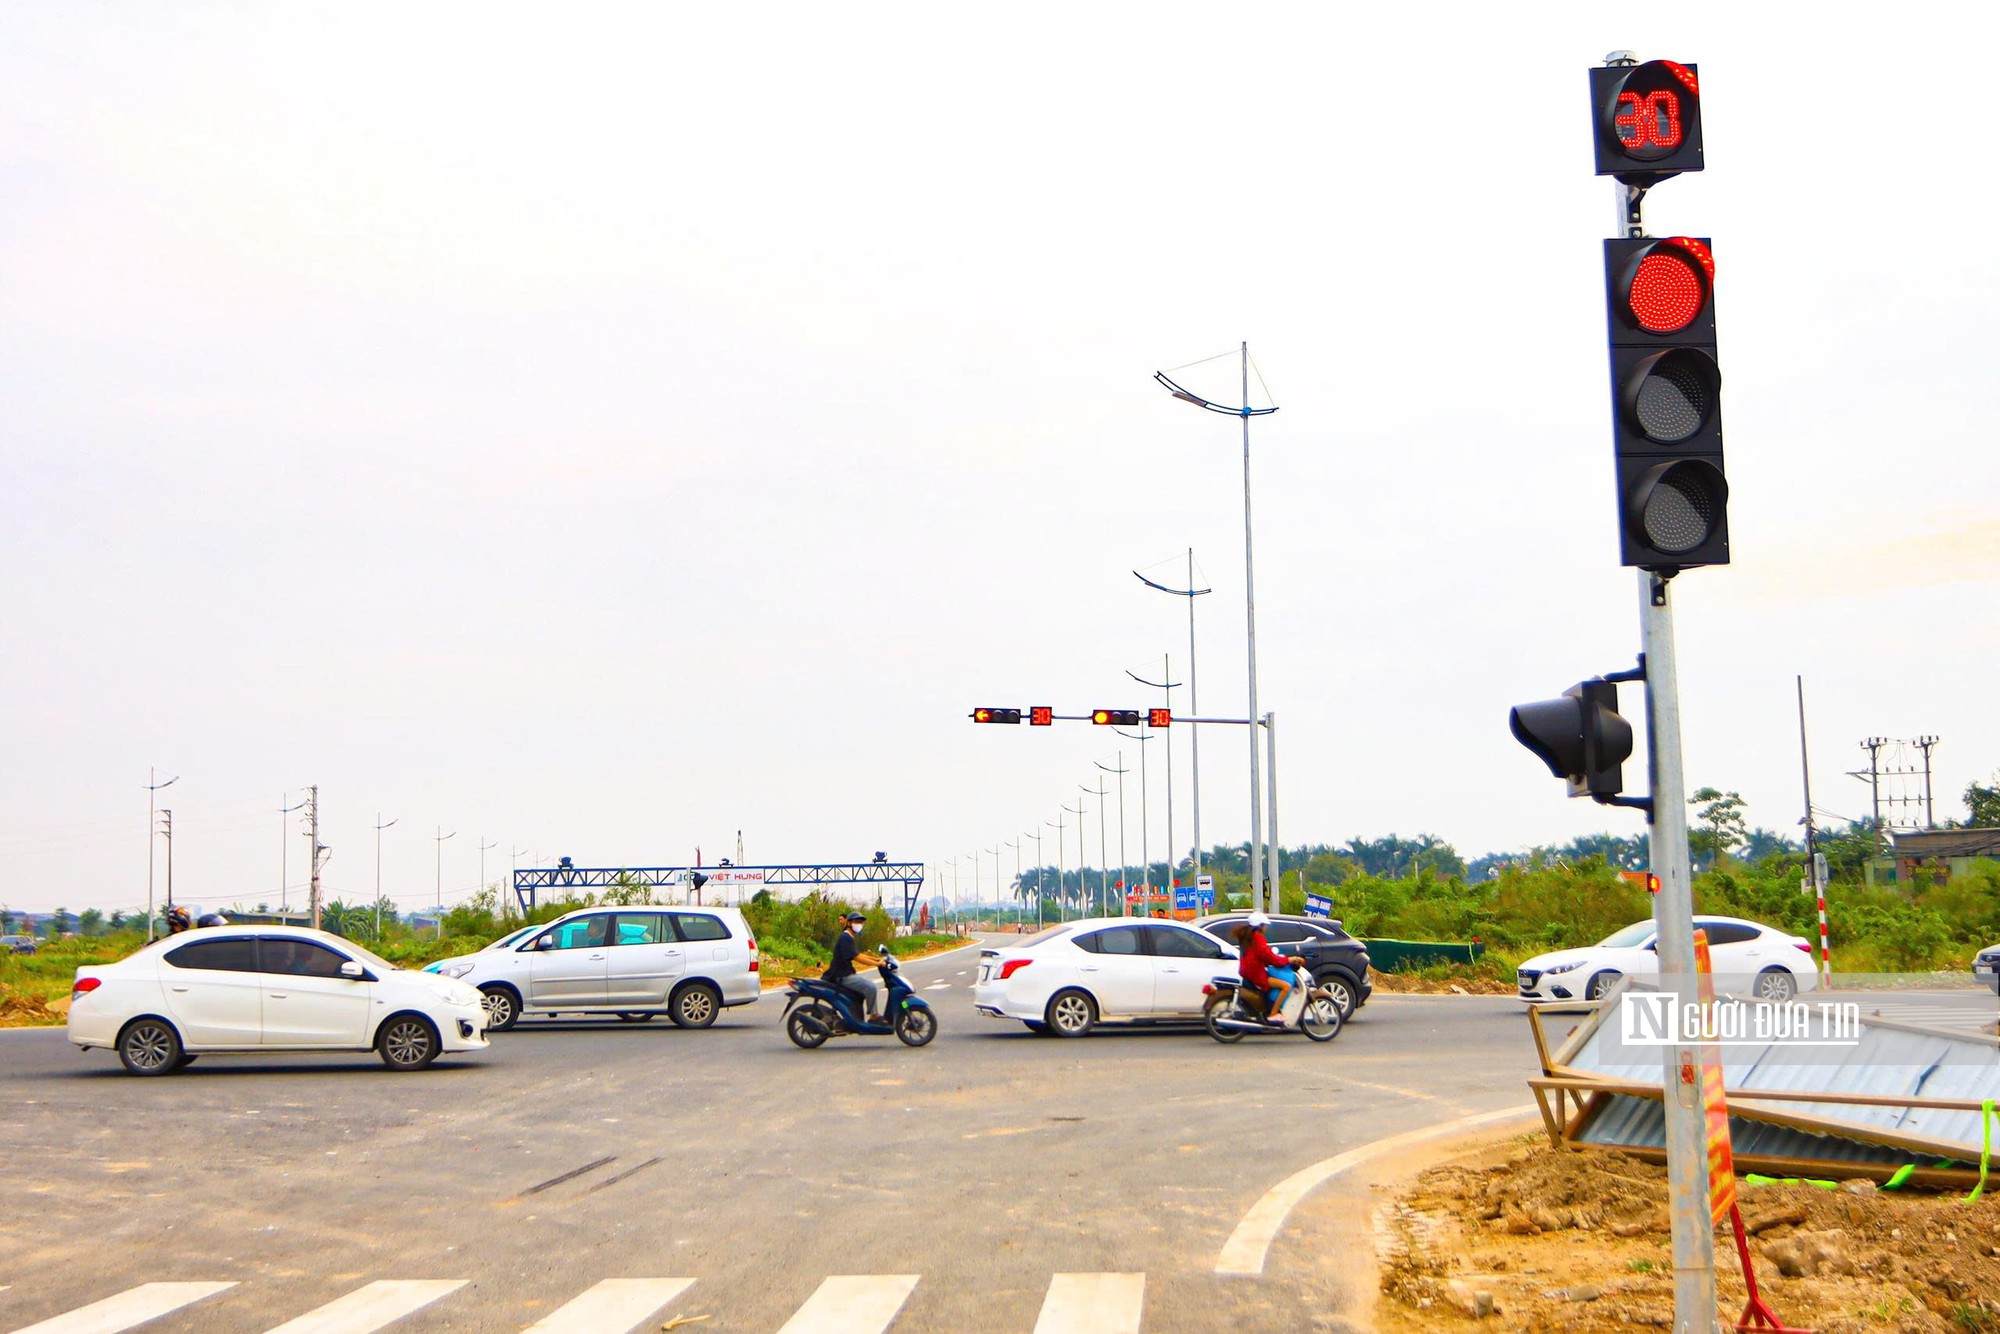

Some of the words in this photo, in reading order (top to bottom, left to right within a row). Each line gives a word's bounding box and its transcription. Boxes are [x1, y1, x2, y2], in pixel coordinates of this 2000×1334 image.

[1616, 90, 1683, 149] 30
[1033, 708, 1050, 724] 30
[1151, 710, 1169, 725] 30
